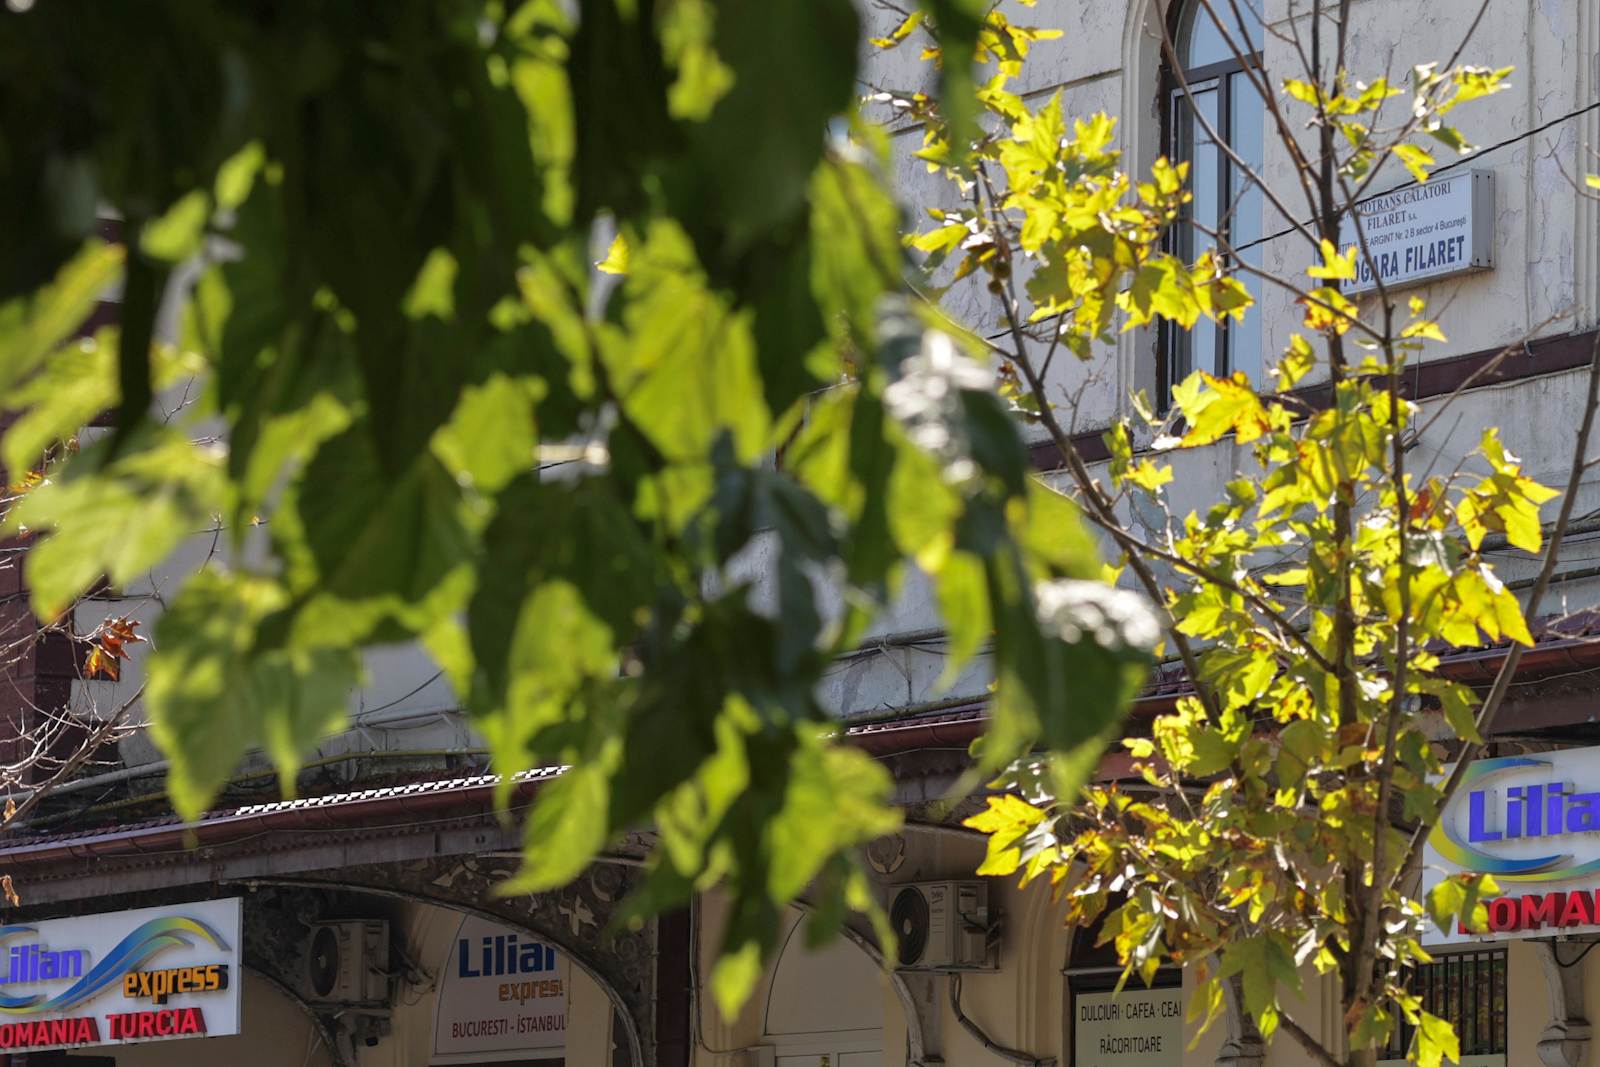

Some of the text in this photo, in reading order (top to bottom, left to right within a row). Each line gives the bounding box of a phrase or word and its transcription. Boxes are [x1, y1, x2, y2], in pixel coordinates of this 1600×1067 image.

[1367, 211, 1407, 231] FILARET
[1369, 232, 1394, 247] ARGINT
[1405, 229, 1410, 239] 2
[1416, 224, 1434, 236] sector
[1434, 223, 1439, 232] 4
[1405, 235, 1465, 273] FILARET
[123, 964, 228, 1005] express
[1081, 1000, 1182, 1022] DULCIURI CAFEA CEAI
[0, 1007, 208, 1048] OMANIA TURCIA
[452, 1018, 509, 1039] BUCURESTI
[1099, 1033, 1162, 1055] RĂCORITOARE
